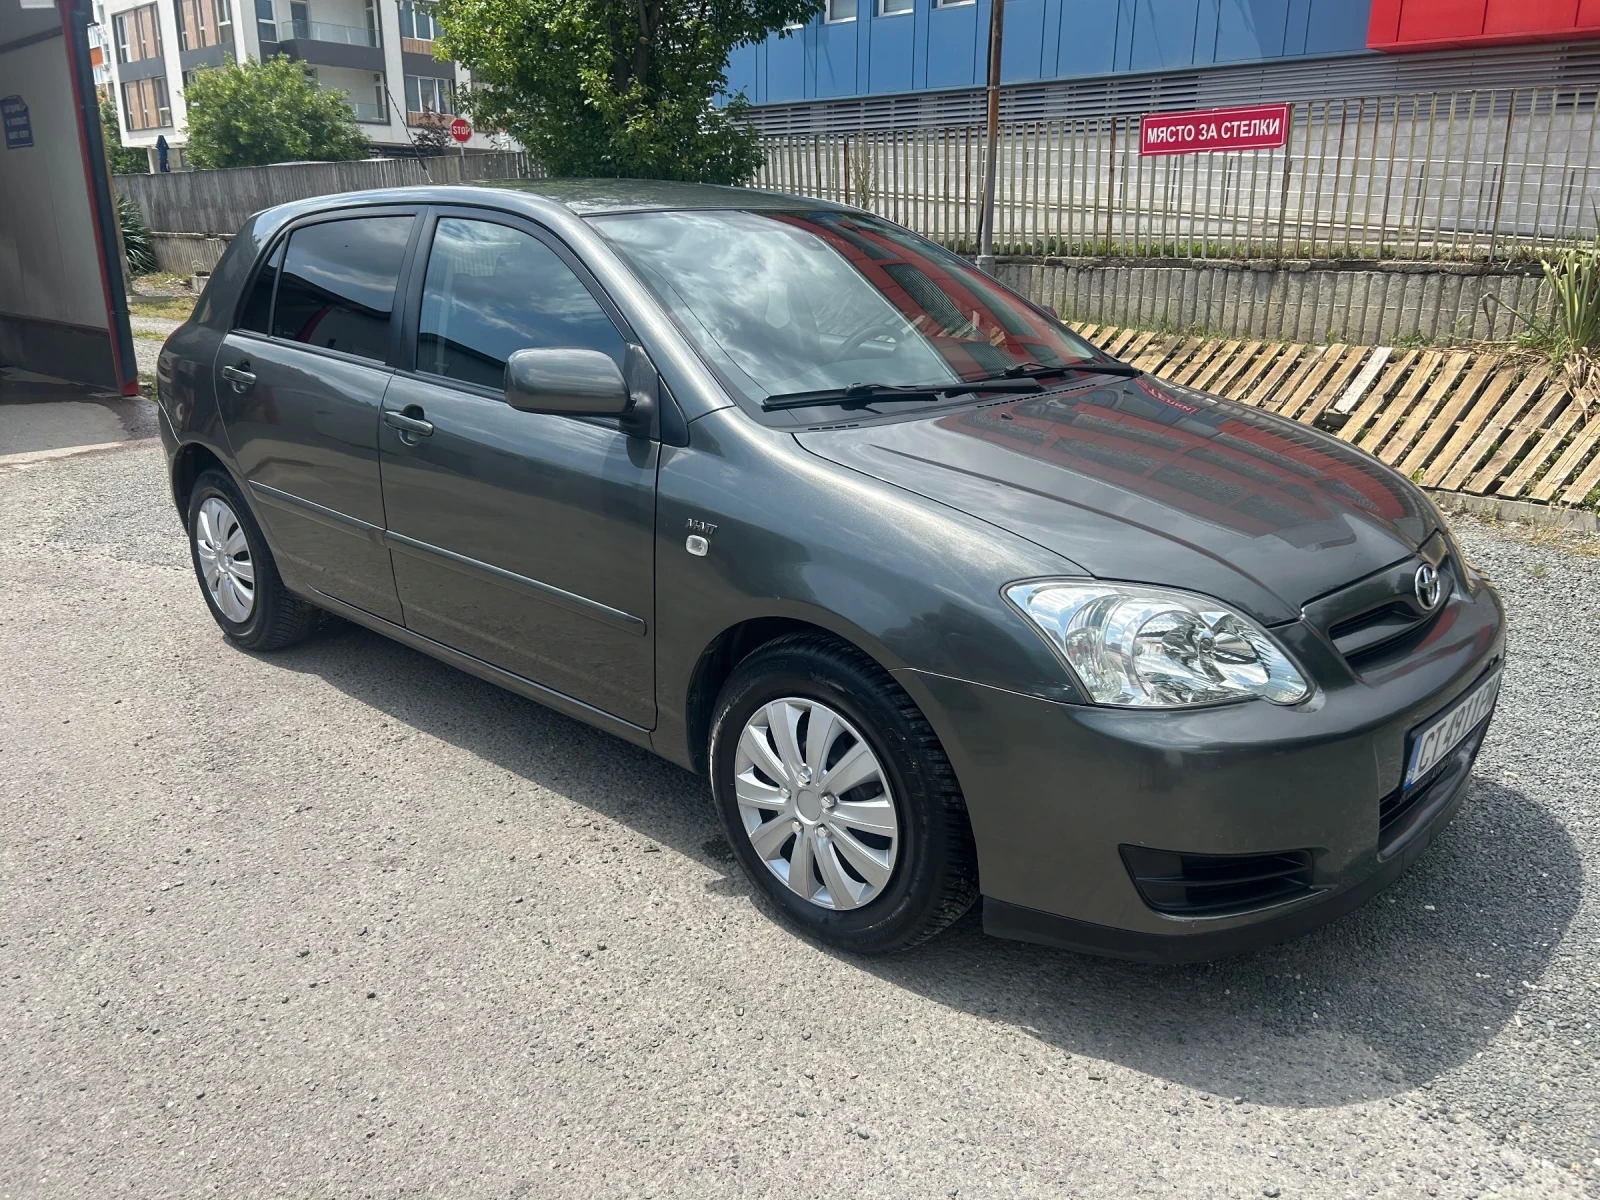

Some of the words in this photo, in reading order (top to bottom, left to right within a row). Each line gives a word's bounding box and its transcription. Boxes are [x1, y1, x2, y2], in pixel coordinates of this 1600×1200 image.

[452, 126, 471, 135] STOP
[1147, 124, 1195, 143] МЯСТО
[1198, 123, 1218, 140] ЗА
[1221, 118, 1280, 138] СТЕЛКИ
